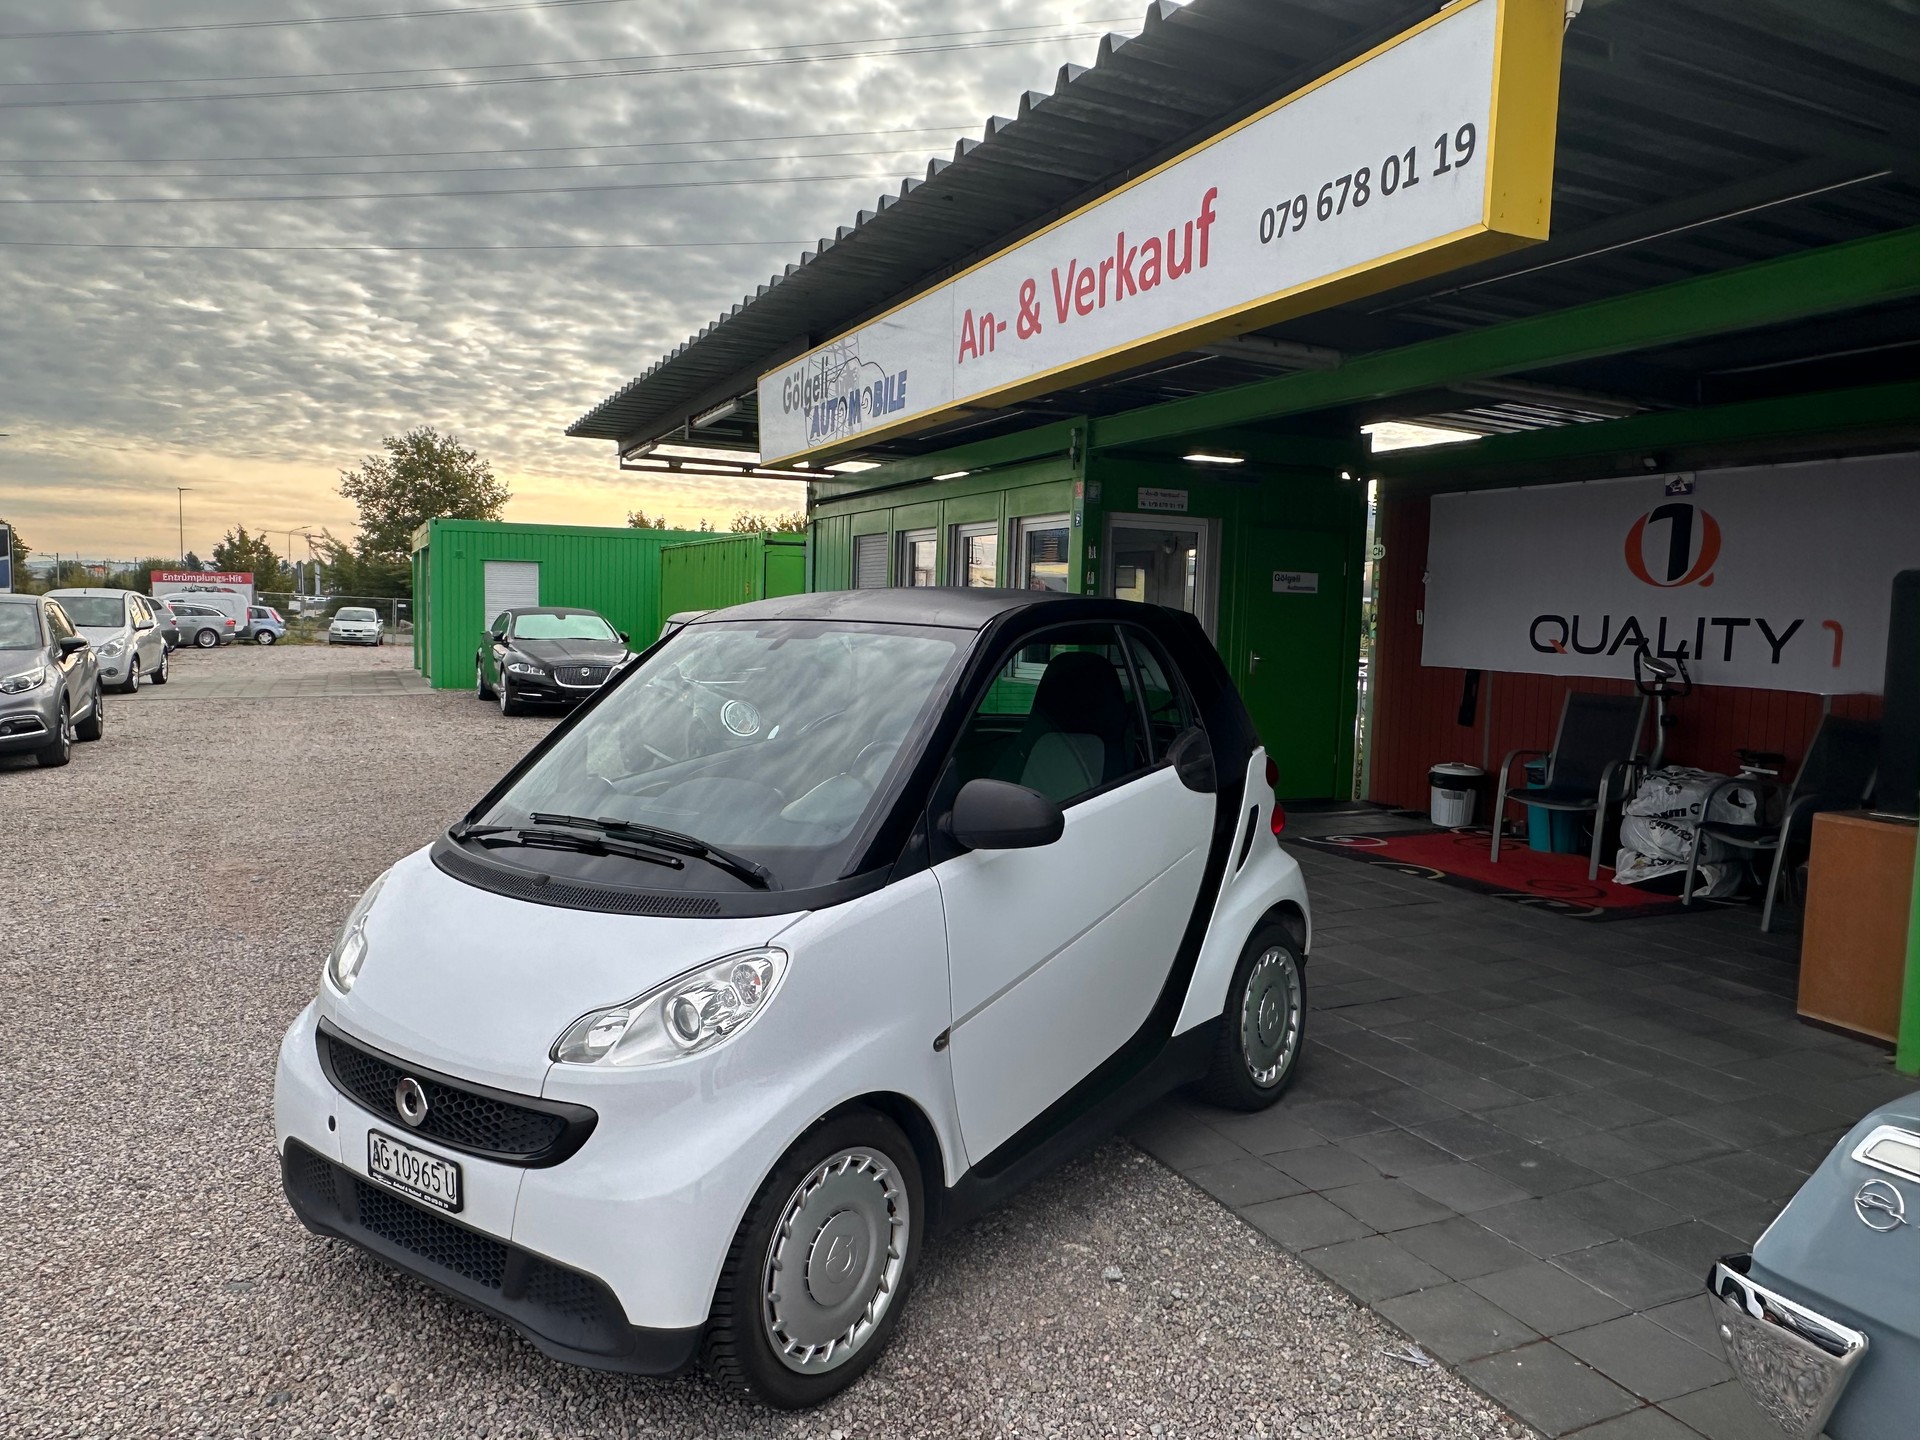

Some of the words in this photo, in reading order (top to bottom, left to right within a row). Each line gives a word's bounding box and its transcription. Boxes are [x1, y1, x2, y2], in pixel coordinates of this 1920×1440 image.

[1259, 194, 1307, 244] 079
[1316, 166, 1371, 223] 678
[1380, 145, 1420, 197] 01
[1433, 122, 1476, 177] 19
[958, 308, 1007, 364] An-
[1016, 278, 1042, 340] &
[1051, 186, 1218, 324] Verkauf
[782, 356, 829, 417] Gölgeli
[811, 370, 908, 439] AUTOMOBILE
[162, 572, 243, 583] Entrümplungs-Hit
[1529, 614, 1805, 665] QUALITY
[1822, 619, 1844, 668] 1
[373, 1140, 390, 1170] AG
[394, 1149, 441, 1193] 10965
